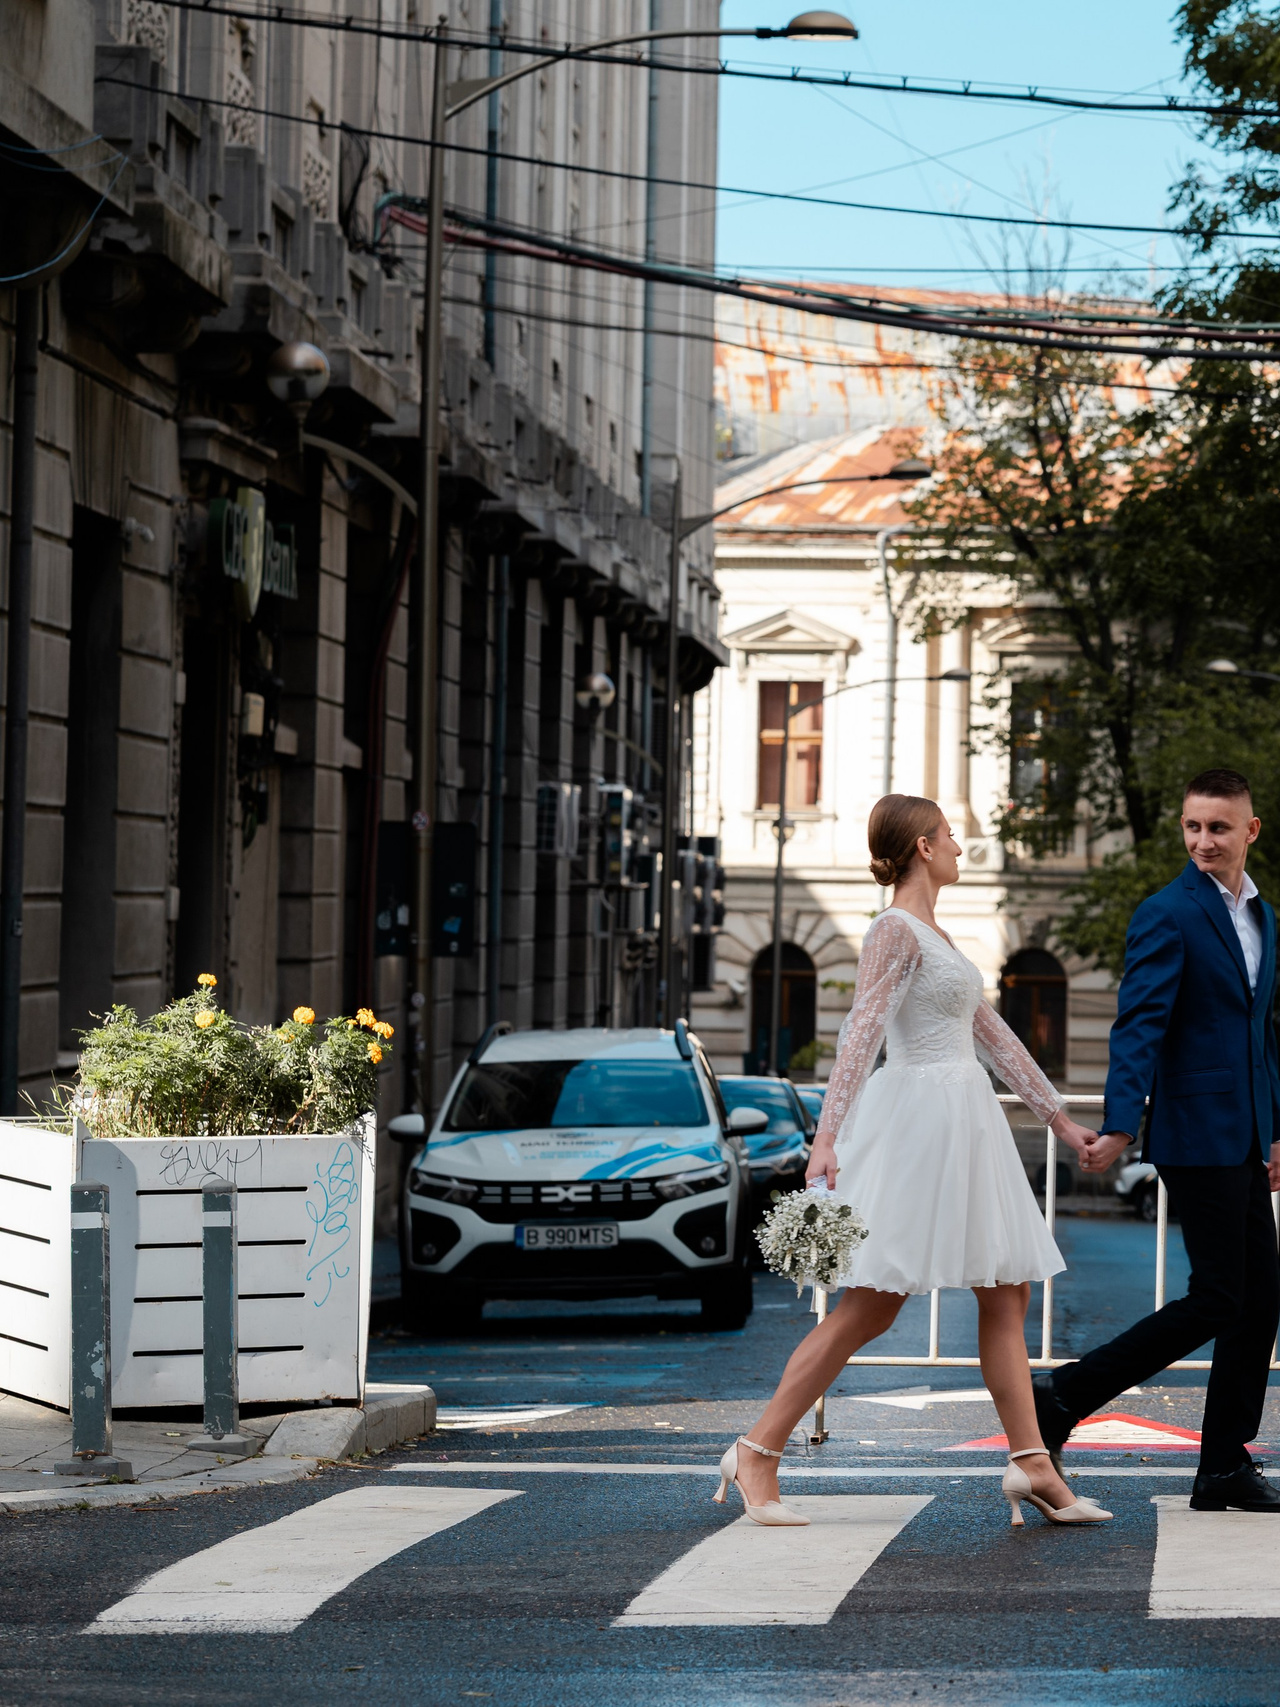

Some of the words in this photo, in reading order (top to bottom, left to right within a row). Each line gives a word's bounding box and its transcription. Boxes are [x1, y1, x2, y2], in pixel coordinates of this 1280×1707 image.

[222, 499, 248, 584] CEC
[263, 518, 298, 599] Bank
[526, 1229, 539, 1245] B
[545, 1228, 576, 1245] 990
[579, 1227, 614, 1244] MTS
